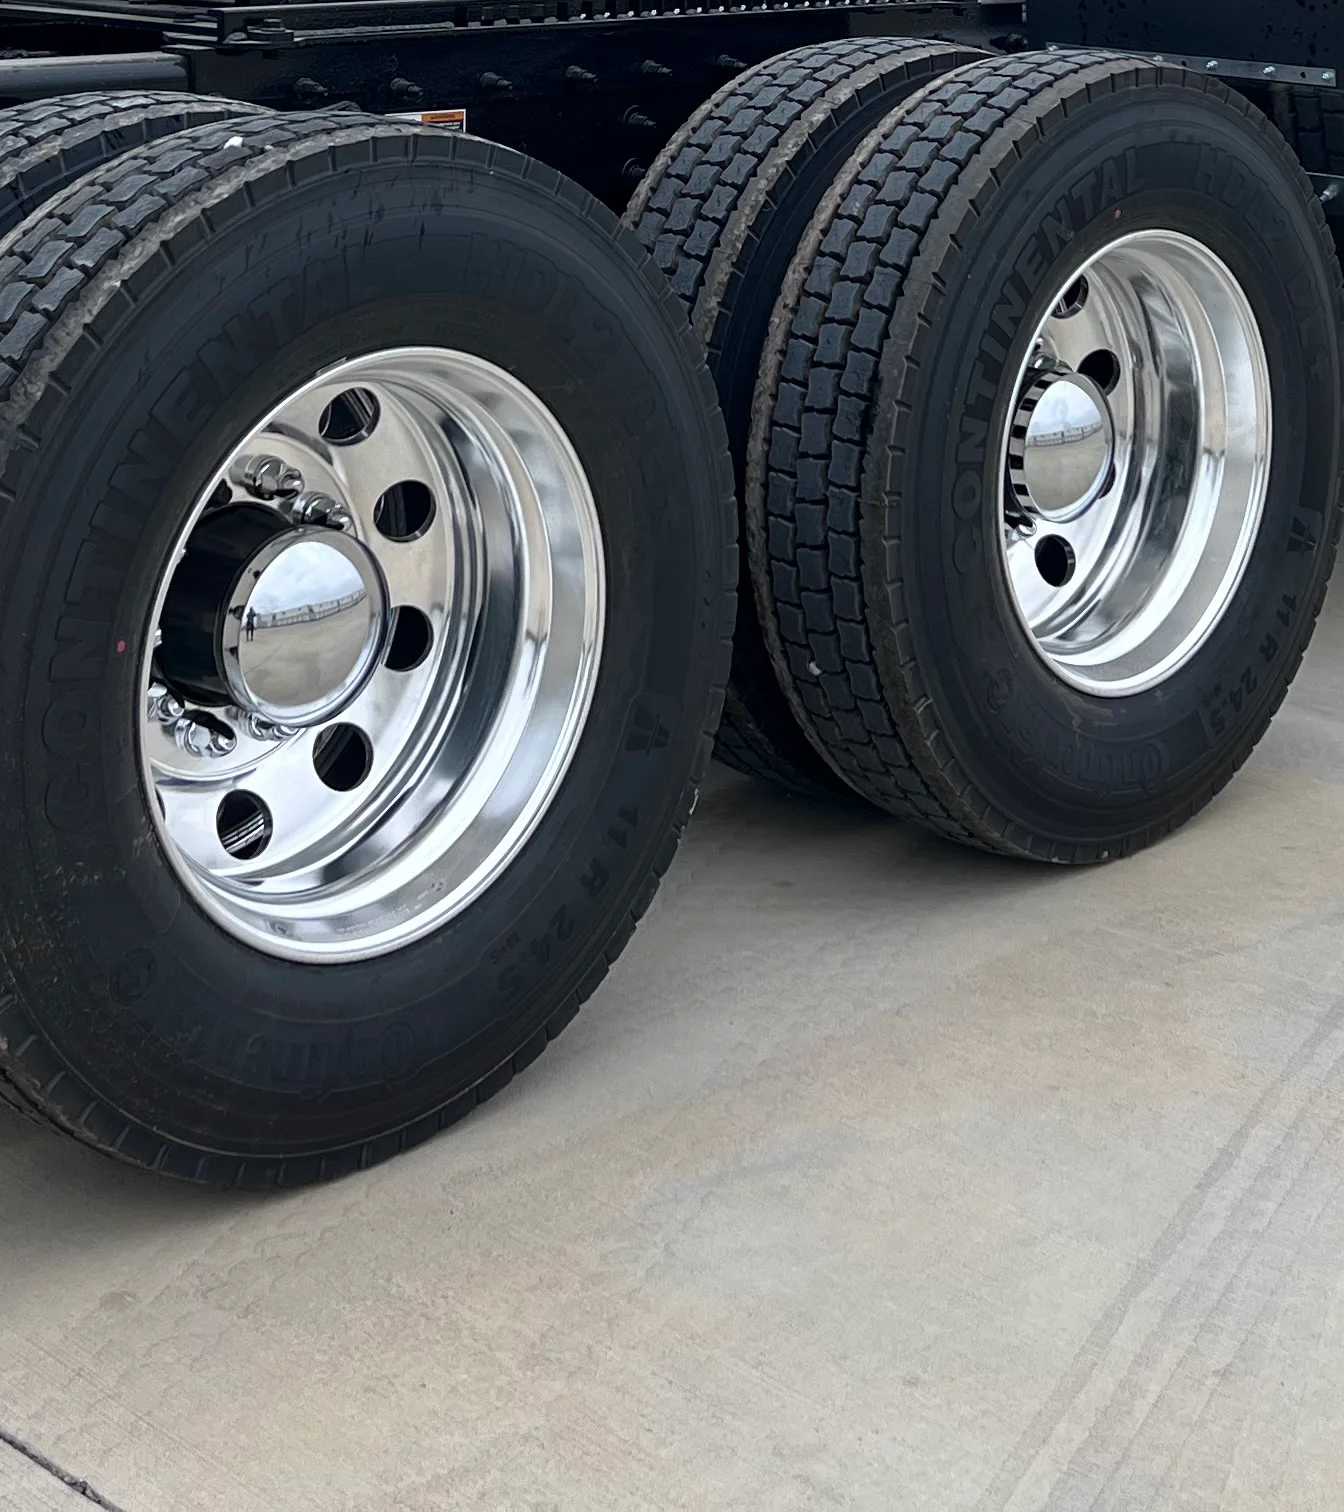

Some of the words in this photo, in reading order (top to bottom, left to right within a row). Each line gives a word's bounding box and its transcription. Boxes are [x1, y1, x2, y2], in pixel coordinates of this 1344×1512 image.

[951, 147, 1145, 576] CONTINENTAL
[1210, 665, 1258, 738] 24.5
[497, 903, 575, 1002] 24.5
